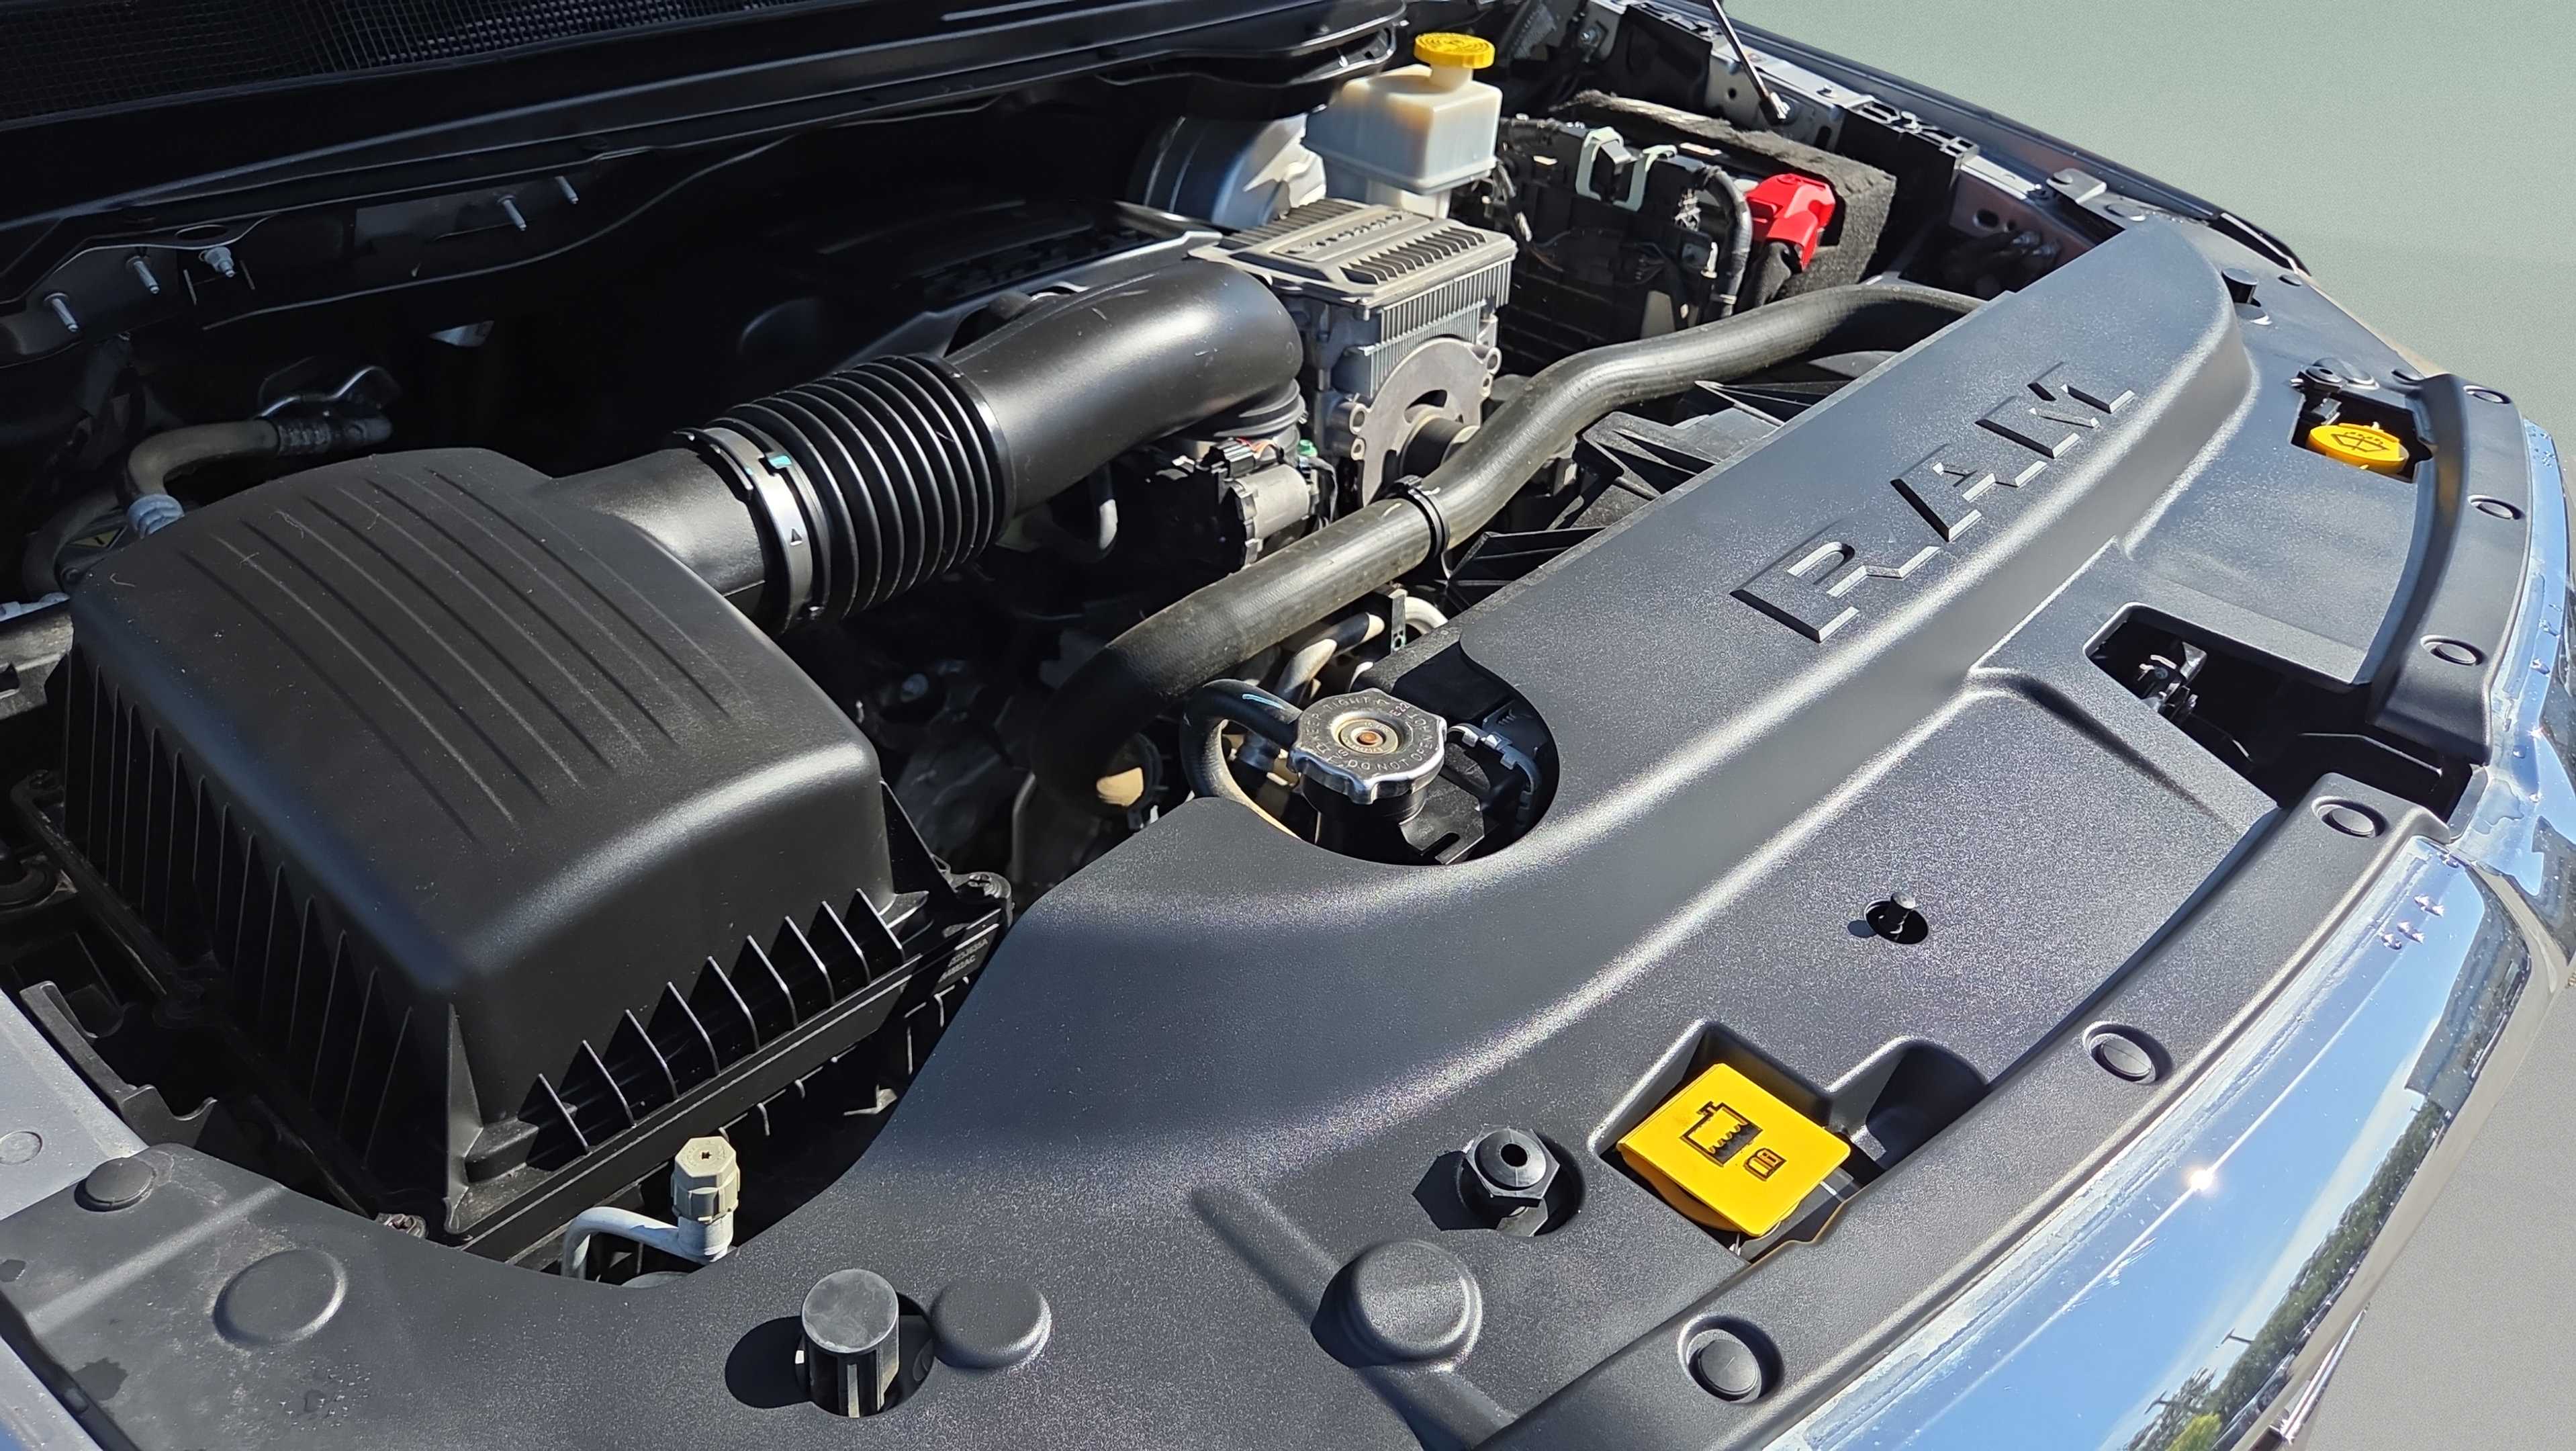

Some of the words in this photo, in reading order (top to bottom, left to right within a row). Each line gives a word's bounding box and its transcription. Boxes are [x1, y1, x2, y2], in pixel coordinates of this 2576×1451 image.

[1730, 361, 2135, 643] RAM
[1303, 713, 1322, 742] KEEP
[1322, 697, 1370, 711] TIGHT
[1389, 702, 1410, 717] E22
[1348, 759, 1371, 771] DO
[1377, 758, 1410, 771] NOT
[1410, 734, 1433, 761] OPEN
